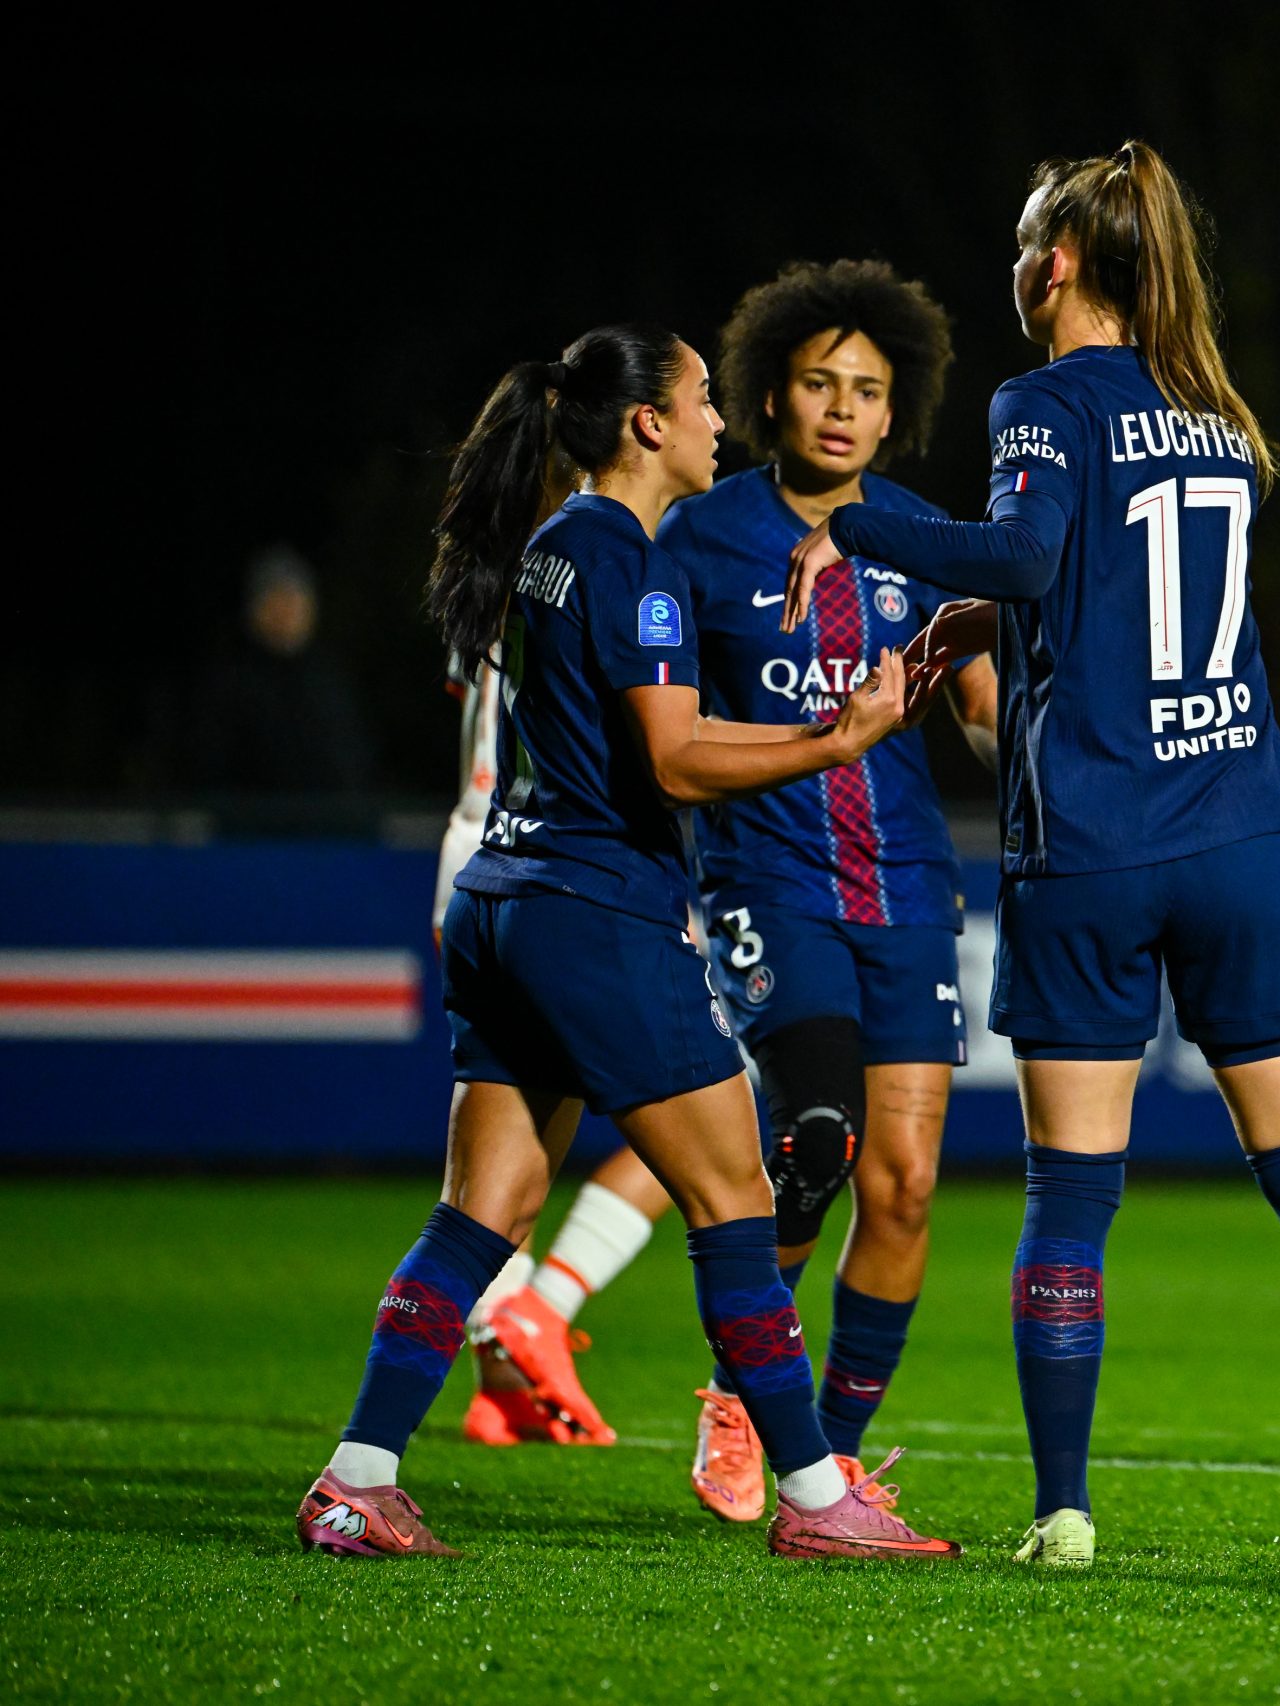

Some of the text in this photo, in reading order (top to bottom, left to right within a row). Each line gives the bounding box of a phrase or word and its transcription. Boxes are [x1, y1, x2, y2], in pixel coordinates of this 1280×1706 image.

[996, 425, 1052, 447] VISIT
[1125, 477, 1252, 681] 17
[761, 658, 869, 701] QATA
[1153, 725, 1257, 762] UNITED
[1030, 1285, 1097, 1299] PARIS
